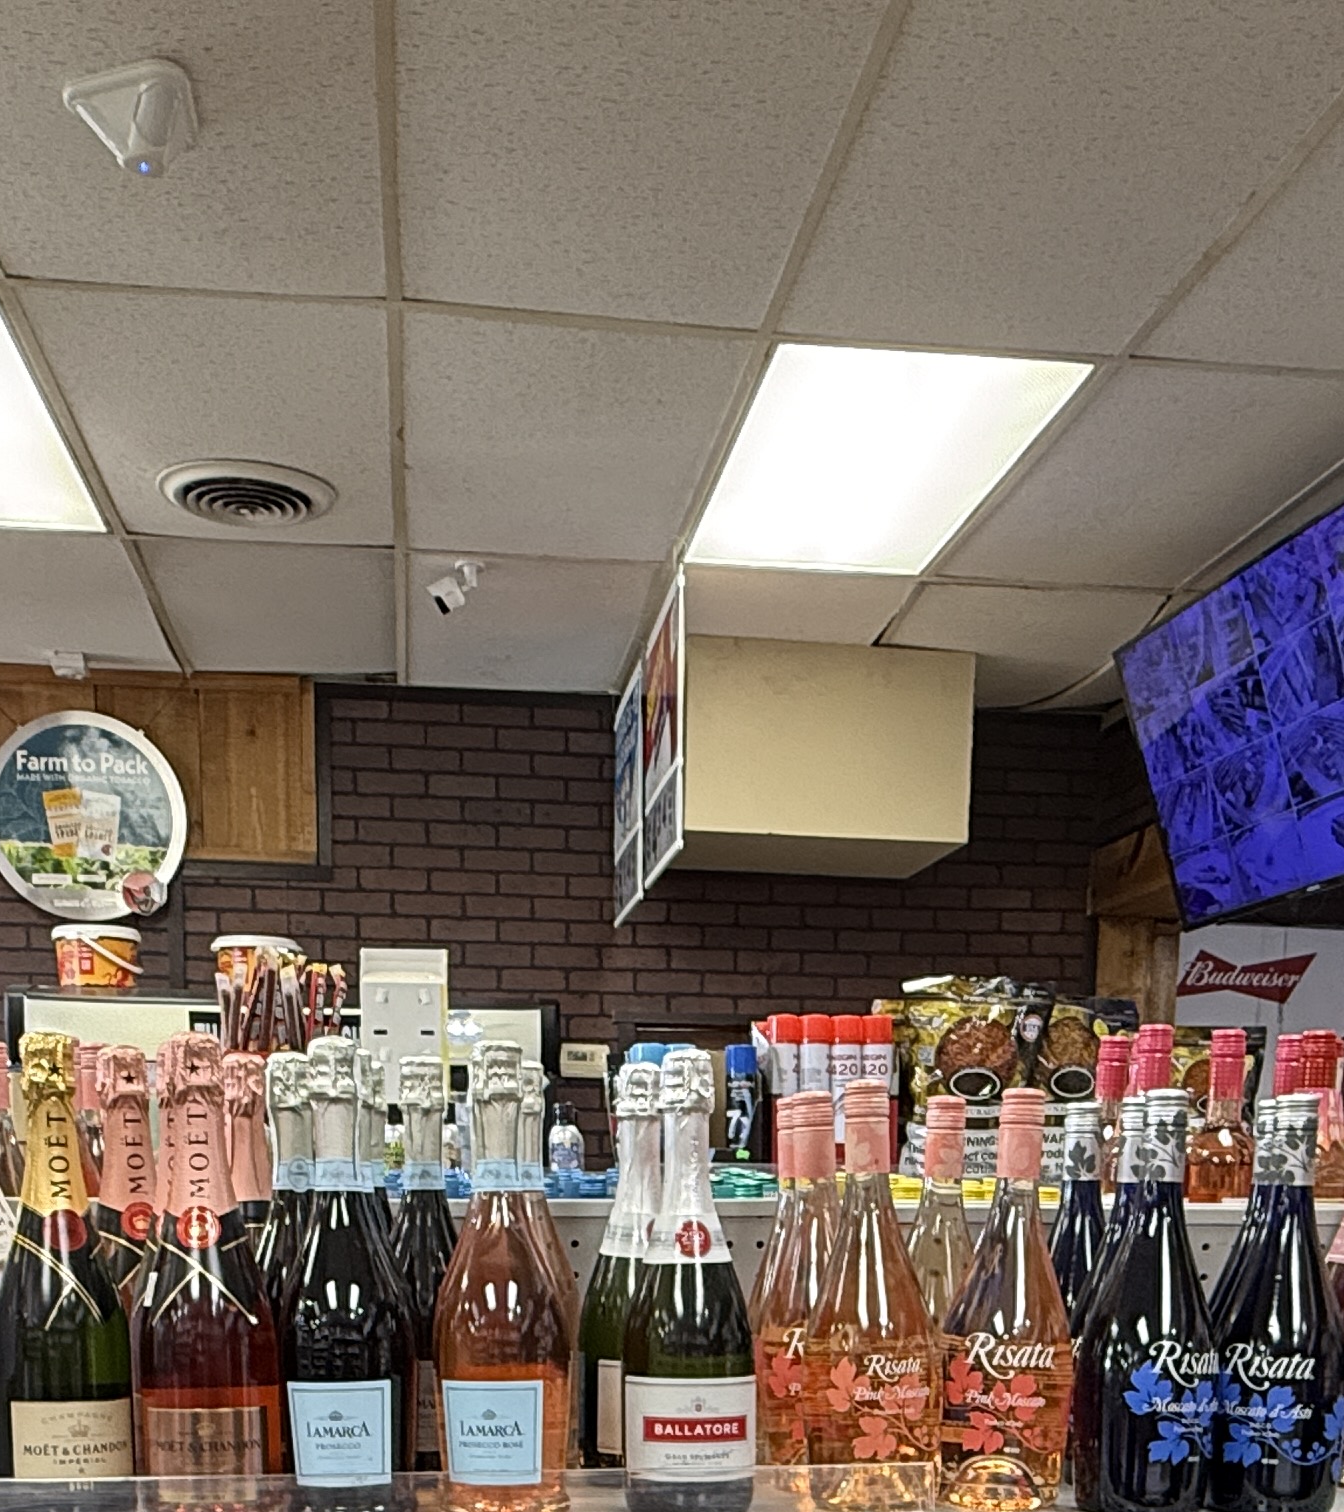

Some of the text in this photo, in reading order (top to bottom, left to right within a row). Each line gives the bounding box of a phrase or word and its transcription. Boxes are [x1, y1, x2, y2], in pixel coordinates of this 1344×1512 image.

[16, 750, 148, 775] Farm to Pack
[1184, 961, 1302, 986] Budweiser
[49, 1110, 72, 1199] MOËT
[188, 1106, 212, 1199] MOËT
[863, 1354, 923, 1383] Risata
[964, 1331, 1054, 1381] Risata
[1225, 1342, 1315, 1391] Risata
[653, 1421, 739, 1435] BALLATORE
[23, 1443, 58, 1456] MOËT
